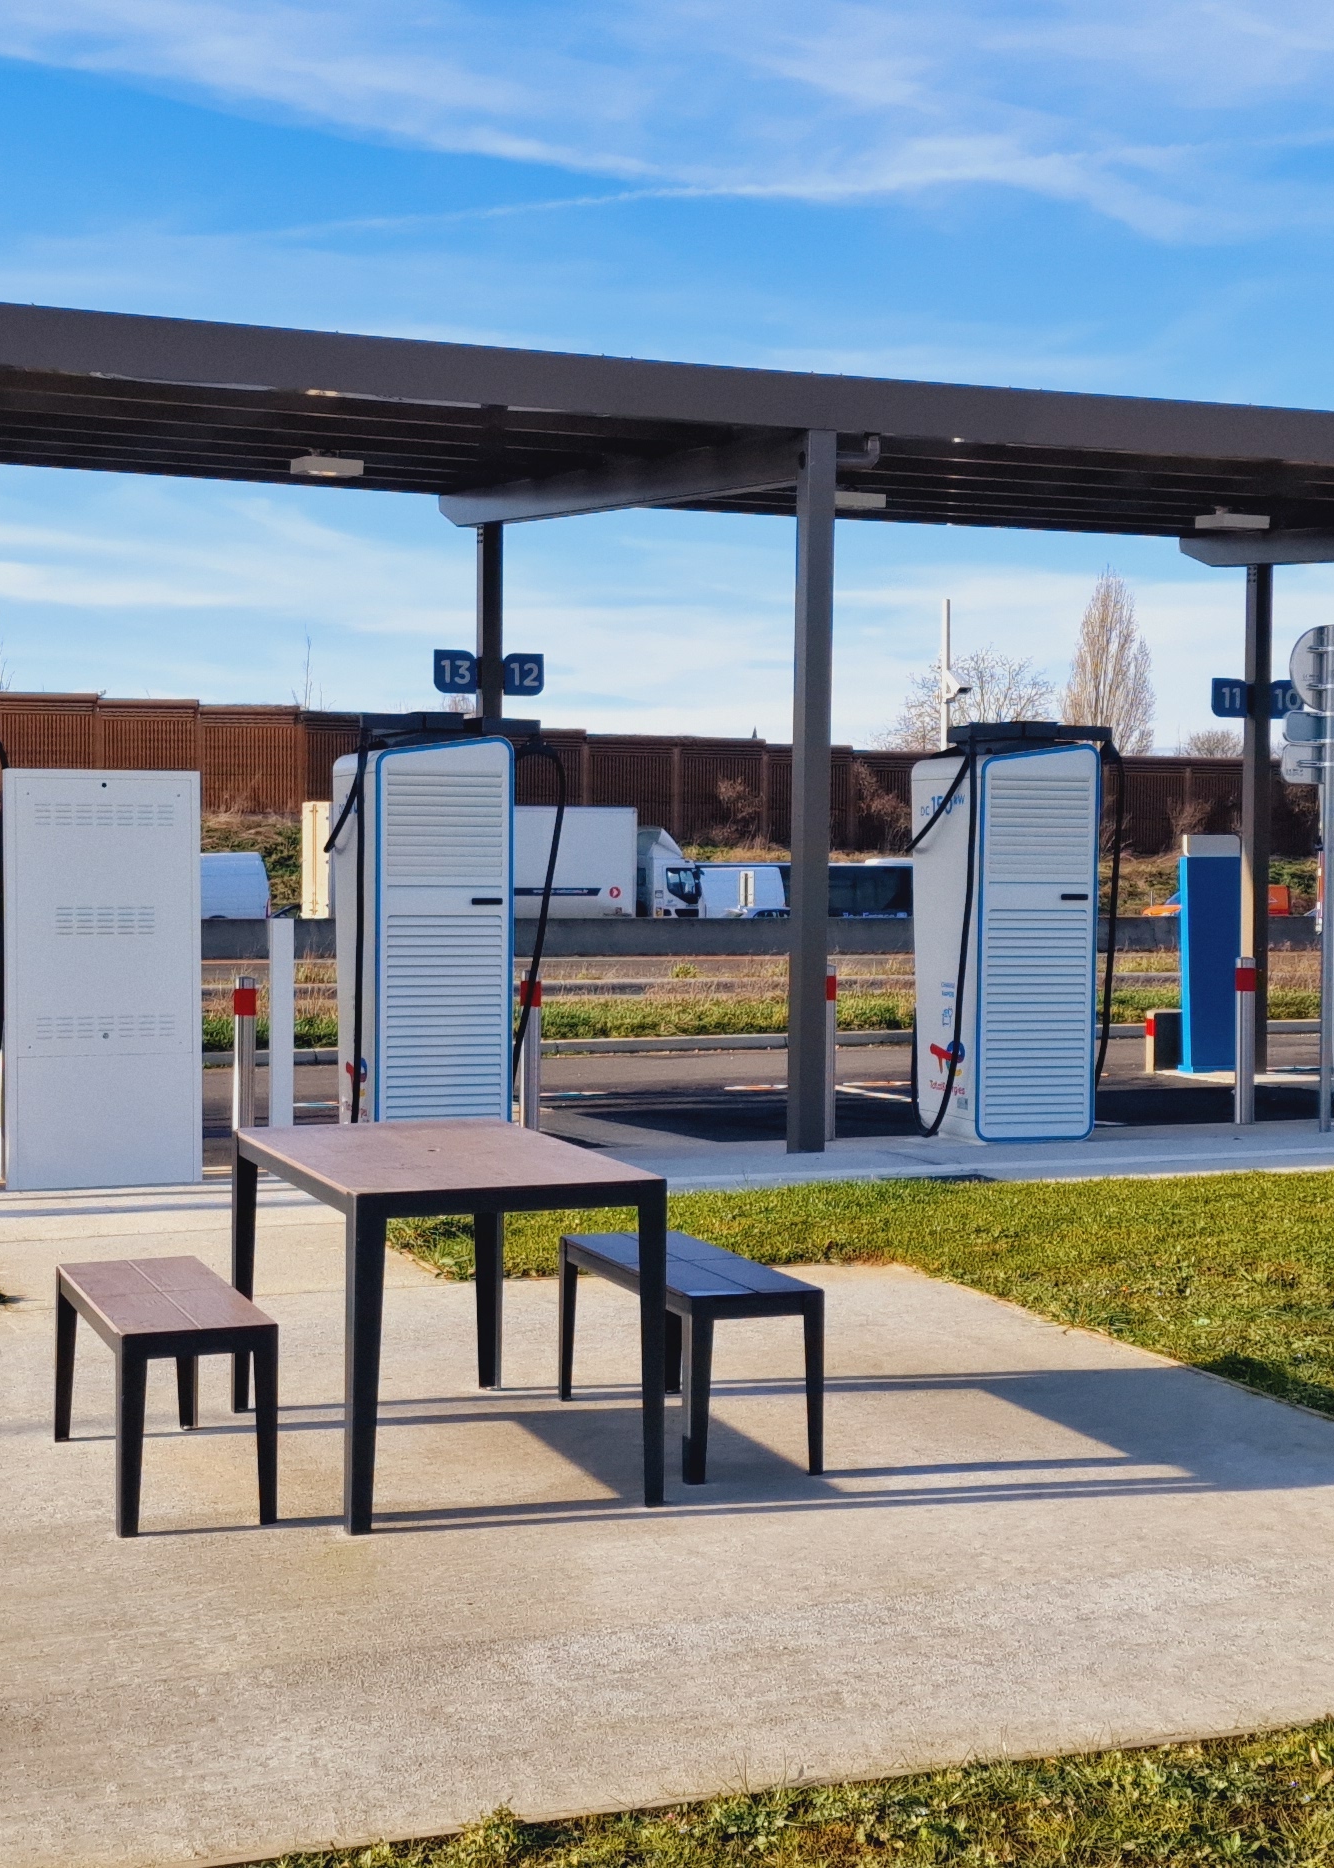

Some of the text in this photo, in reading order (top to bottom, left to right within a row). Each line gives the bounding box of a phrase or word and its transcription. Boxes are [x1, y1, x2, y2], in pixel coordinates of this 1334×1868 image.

[441, 660, 471, 685] 13
[510, 663, 540, 687] 12
[1222, 687, 1241, 710] 11
[1275, 688, 1301, 710] 10
